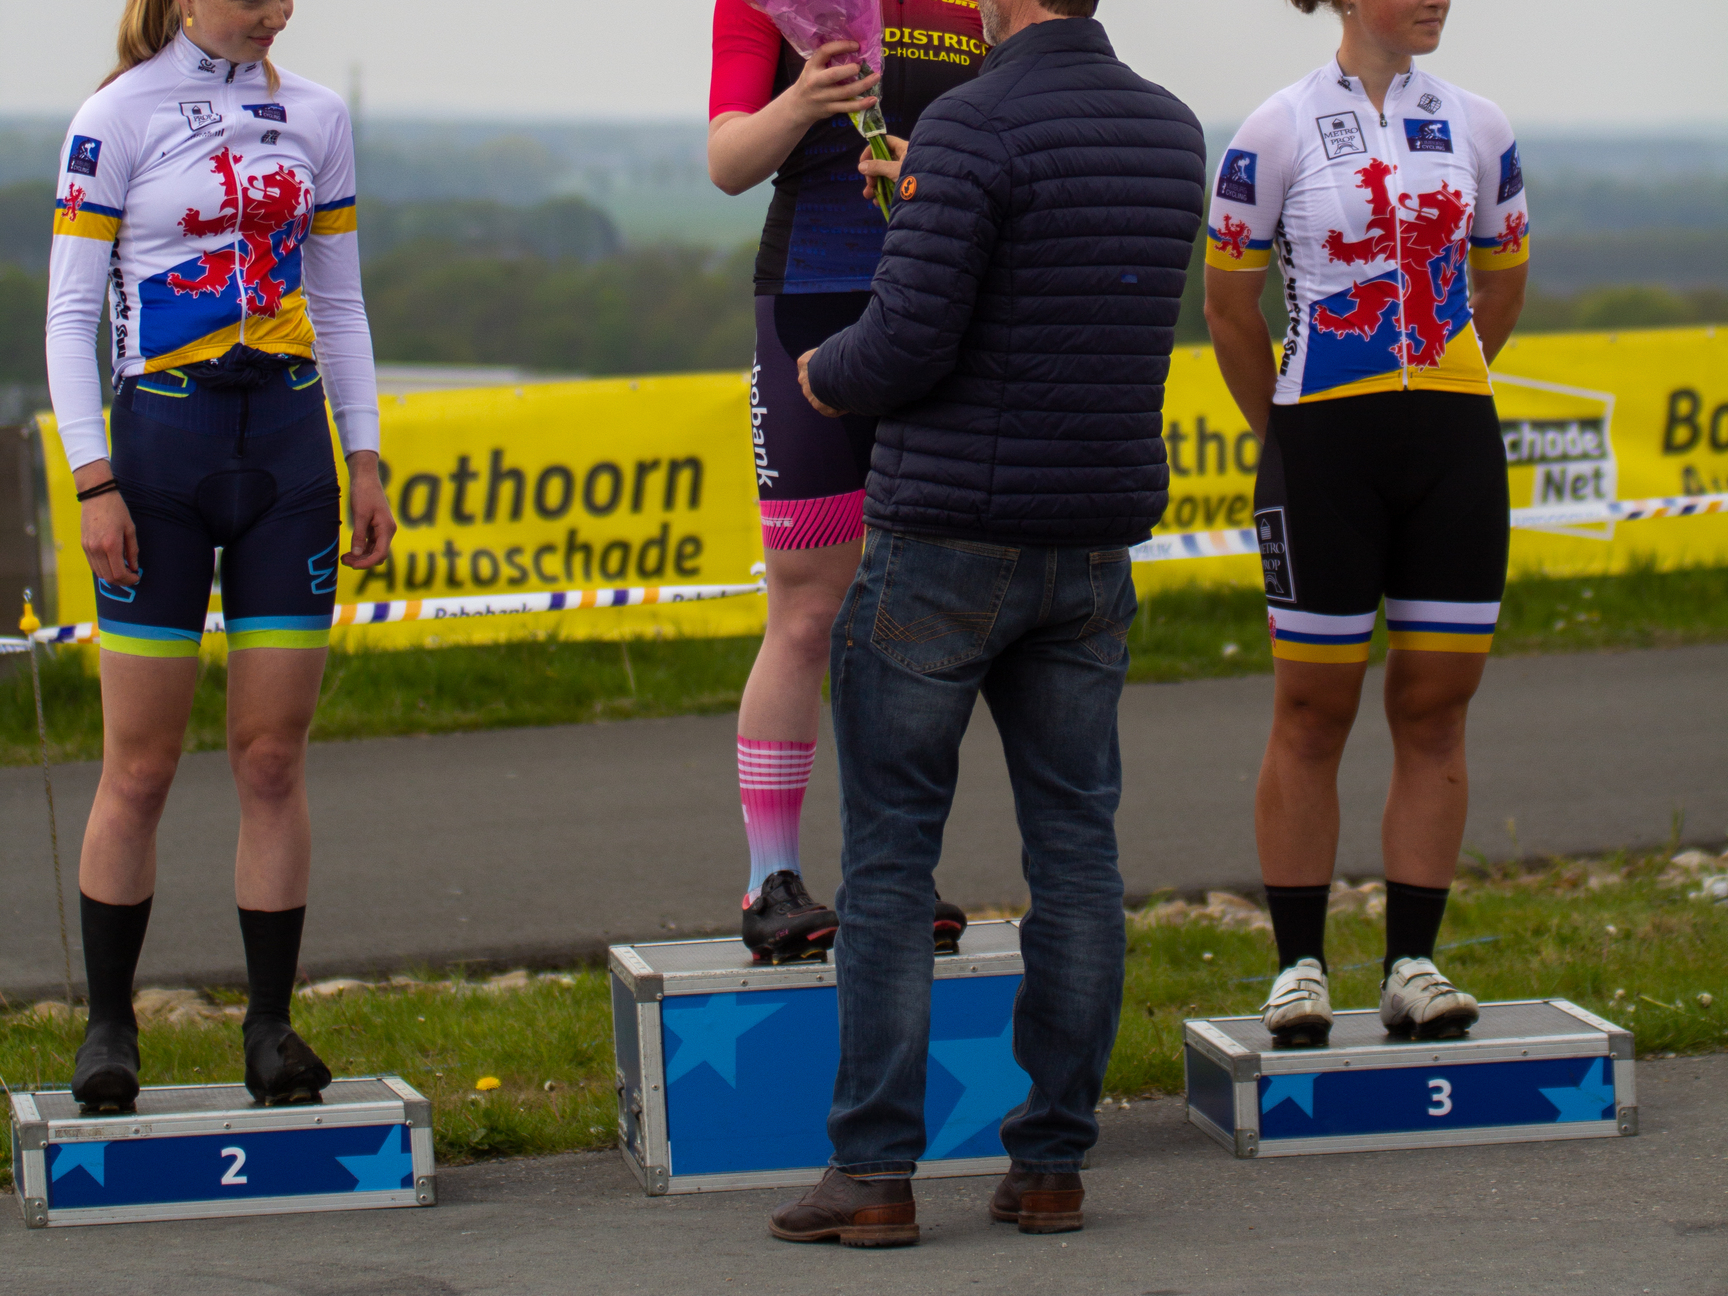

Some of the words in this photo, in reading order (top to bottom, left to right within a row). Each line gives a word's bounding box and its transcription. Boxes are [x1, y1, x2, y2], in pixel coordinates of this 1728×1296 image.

[1323, 126, 1359, 140] METRO
[1330, 135, 1356, 146] PROP
[1225, 188, 1248, 202] CYCLING
[750, 353, 779, 489] bobank
[1541, 467, 1606, 503] Net
[355, 521, 704, 595] Autoschade
[1428, 1078, 1453, 1117] 3
[220, 1146, 248, 1186] 2
